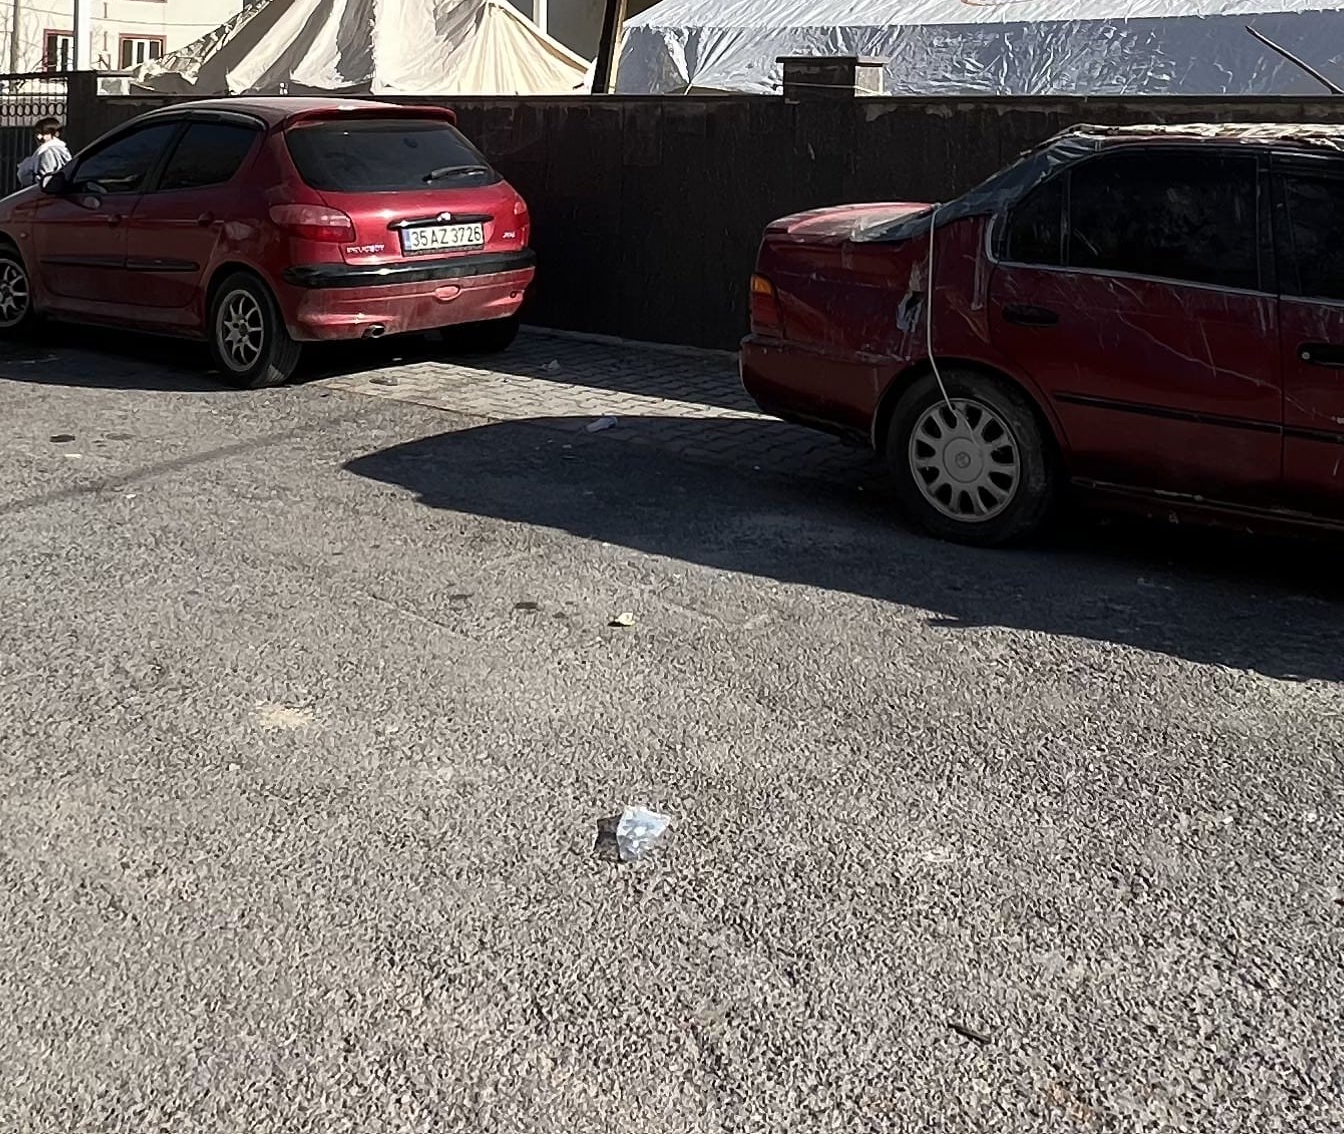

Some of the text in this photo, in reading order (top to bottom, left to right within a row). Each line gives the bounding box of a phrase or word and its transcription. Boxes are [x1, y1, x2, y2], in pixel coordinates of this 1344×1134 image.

[411, 225, 482, 248] 35 AZ 3726
